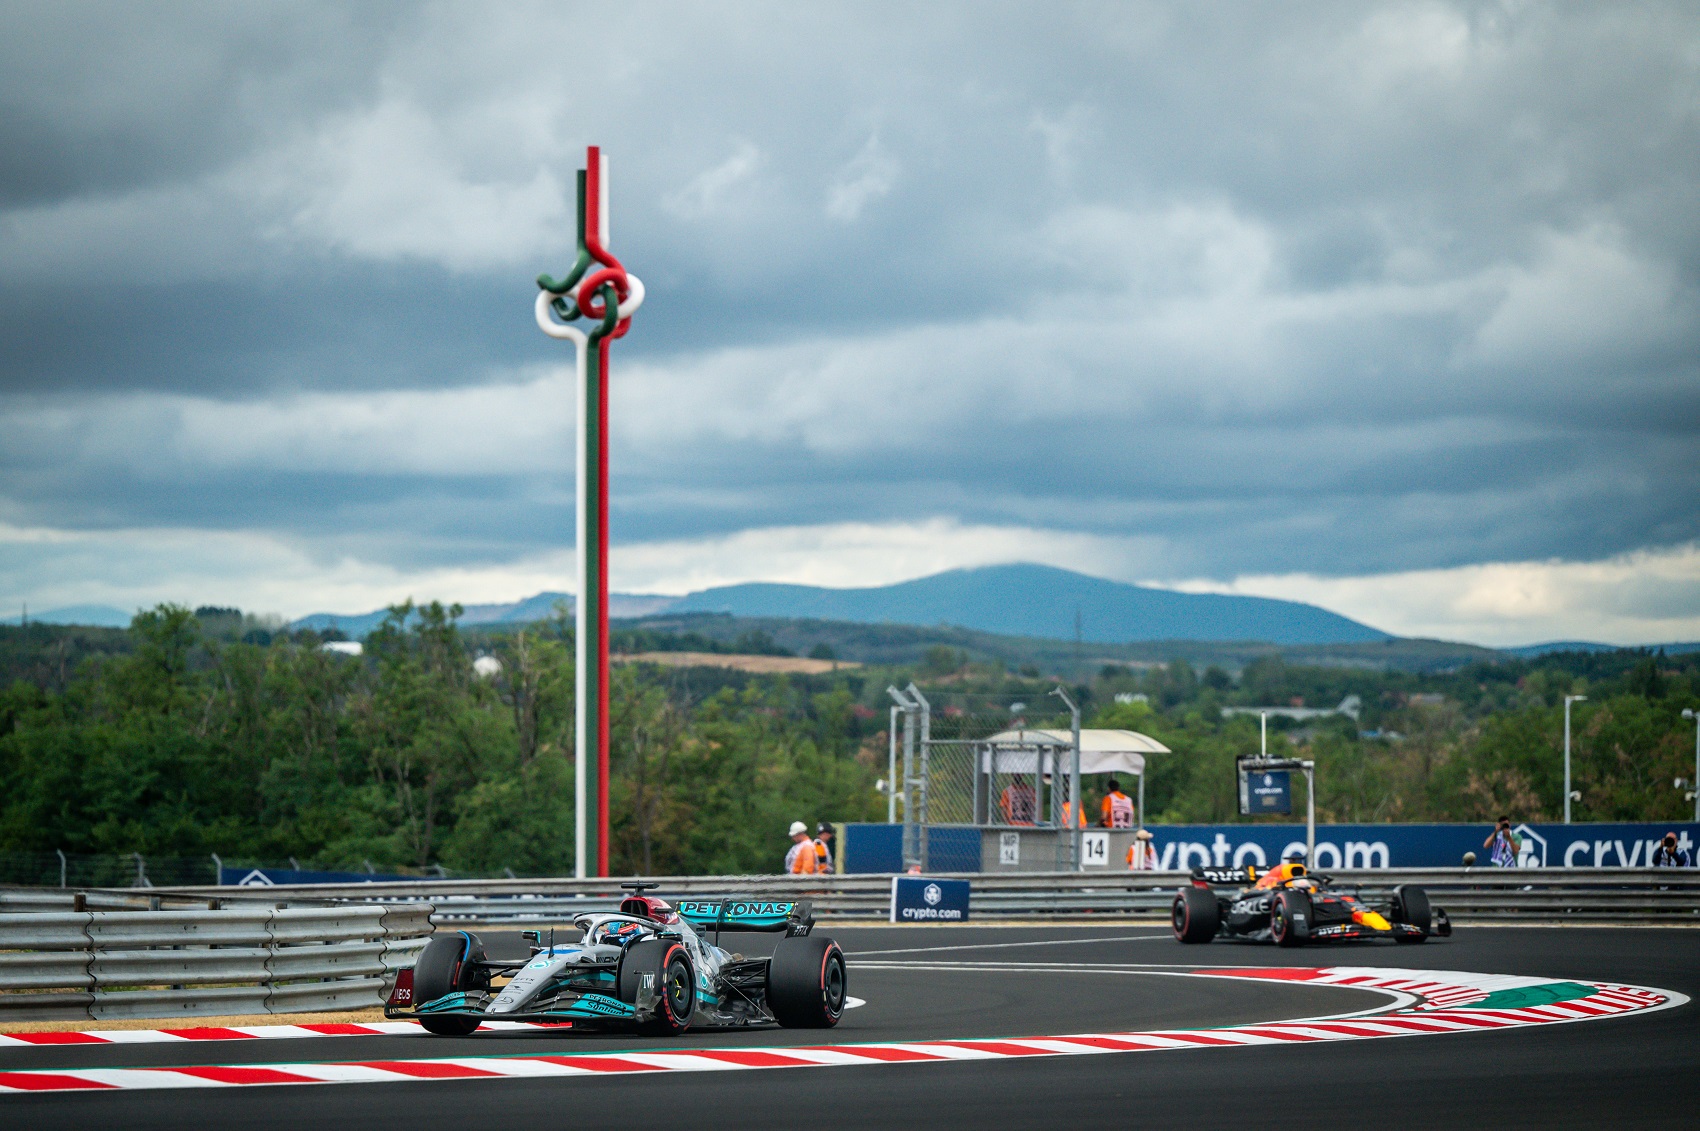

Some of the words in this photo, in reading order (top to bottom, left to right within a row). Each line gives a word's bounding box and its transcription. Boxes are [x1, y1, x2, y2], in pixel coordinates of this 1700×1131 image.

[1085, 839, 1104, 858] 14
[1150, 833, 1390, 869] yptocom
[1564, 831, 1700, 868] cryt
[684, 902, 788, 916] PETRONAS
[902, 907, 961, 920] crypto.com
[643, 974, 655, 988] IWC
